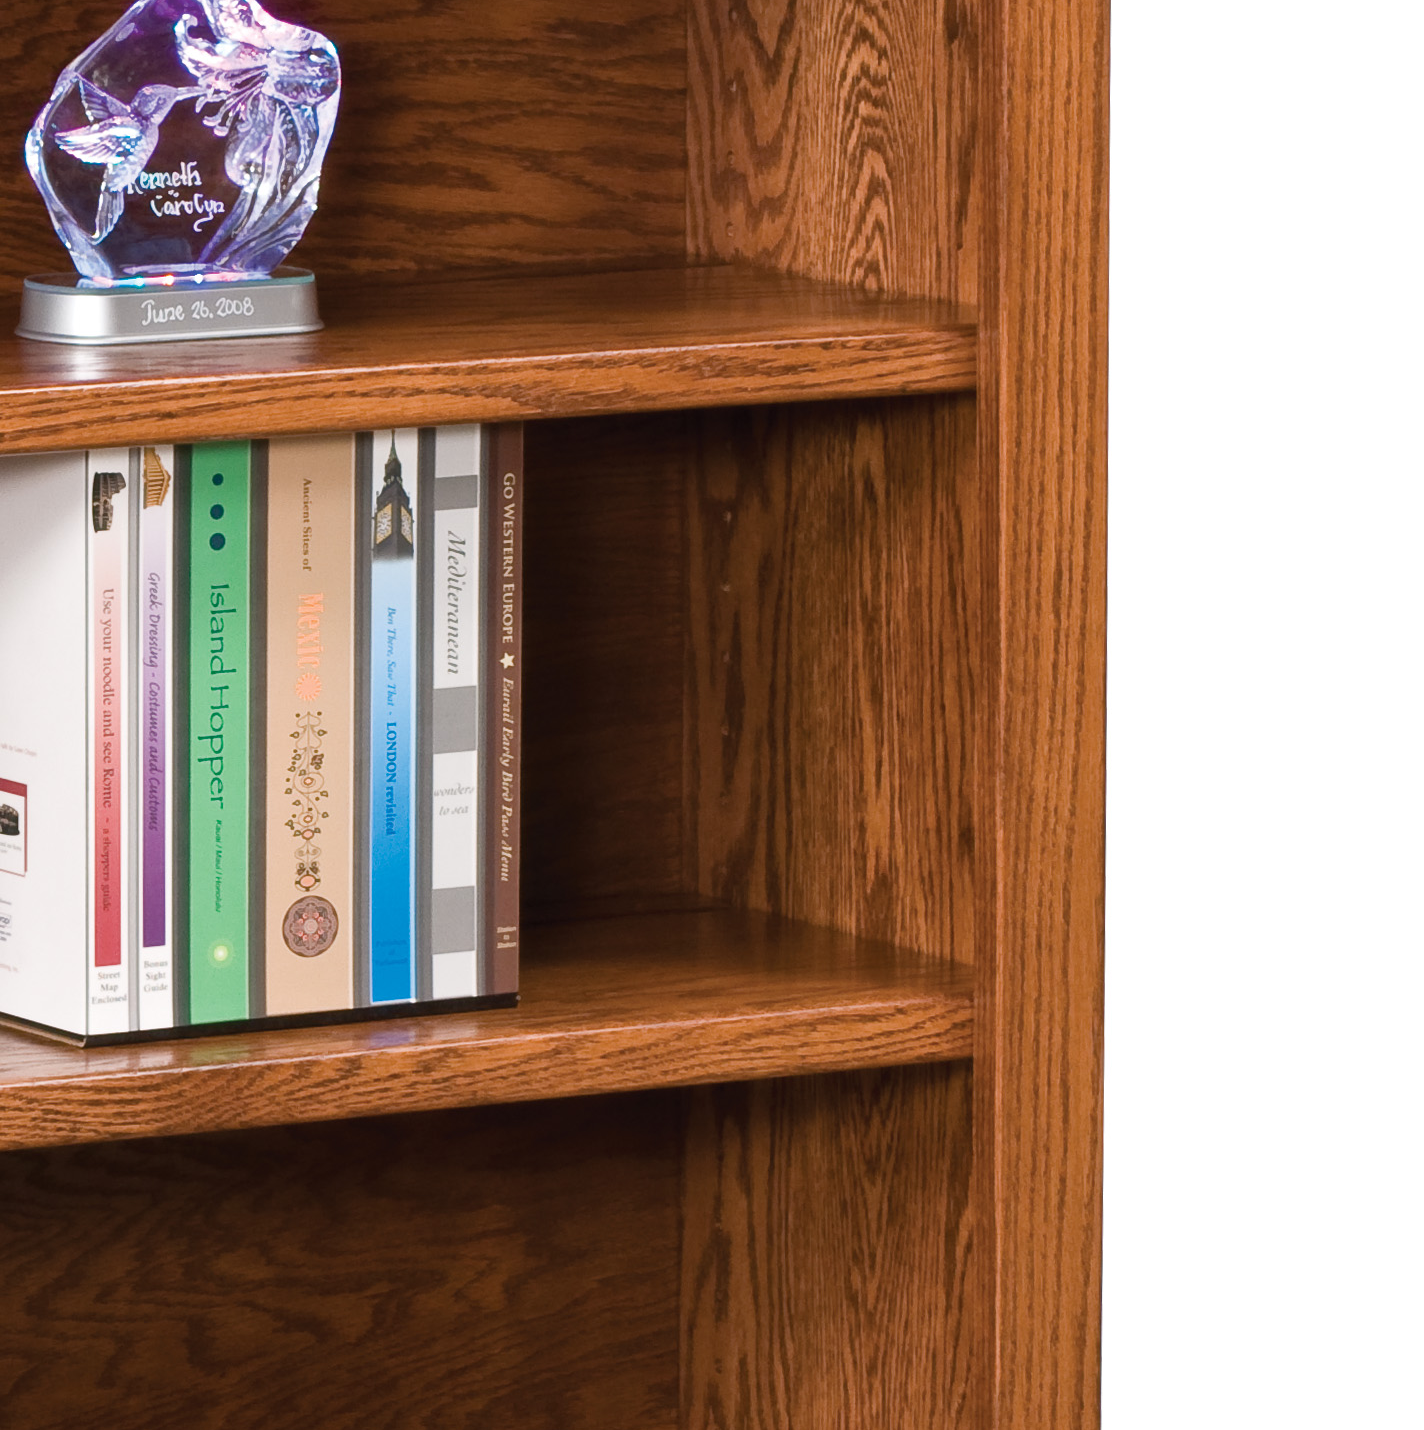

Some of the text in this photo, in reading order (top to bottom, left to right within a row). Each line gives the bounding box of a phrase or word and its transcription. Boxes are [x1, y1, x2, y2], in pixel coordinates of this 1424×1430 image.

[150, 193, 226, 232] Carolyn
[141, 299, 185, 326] June
[216, 297, 254, 317] 2008
[302, 477, 313, 571] Ancient Sites of
[502, 472, 516, 644] GO WESTERN EUROPE
[102, 588, 114, 615] Use
[148, 572, 163, 611] Greek
[447, 530, 467, 675] Mediteranean
[387, 606, 397, 625] Ben
[100, 619, 113, 654] your
[143, 613, 161, 670] Dressing
[102, 657, 114, 706] noodle
[197, 583, 237, 810] Island Hopper
[102, 709, 114, 738] and
[148, 682, 161, 743] Costumes
[103, 741, 113, 764] see
[148, 746, 163, 776] and
[386, 722, 397, 783] LONDON
[102, 768, 114, 809] Rome
[499, 676, 515, 882] Eurail Early Bird Pass Menu
[148, 777, 161, 832] Customs
[386, 785, 397, 836] revisited
[97, 971, 121, 980] Street
[143, 960, 168, 969] Bonus
[145, 971, 167, 981] Sight
[91, 994, 128, 1005] Enclosed
[100, 983, 119, 992] Map
[143, 983, 168, 992] Guide
